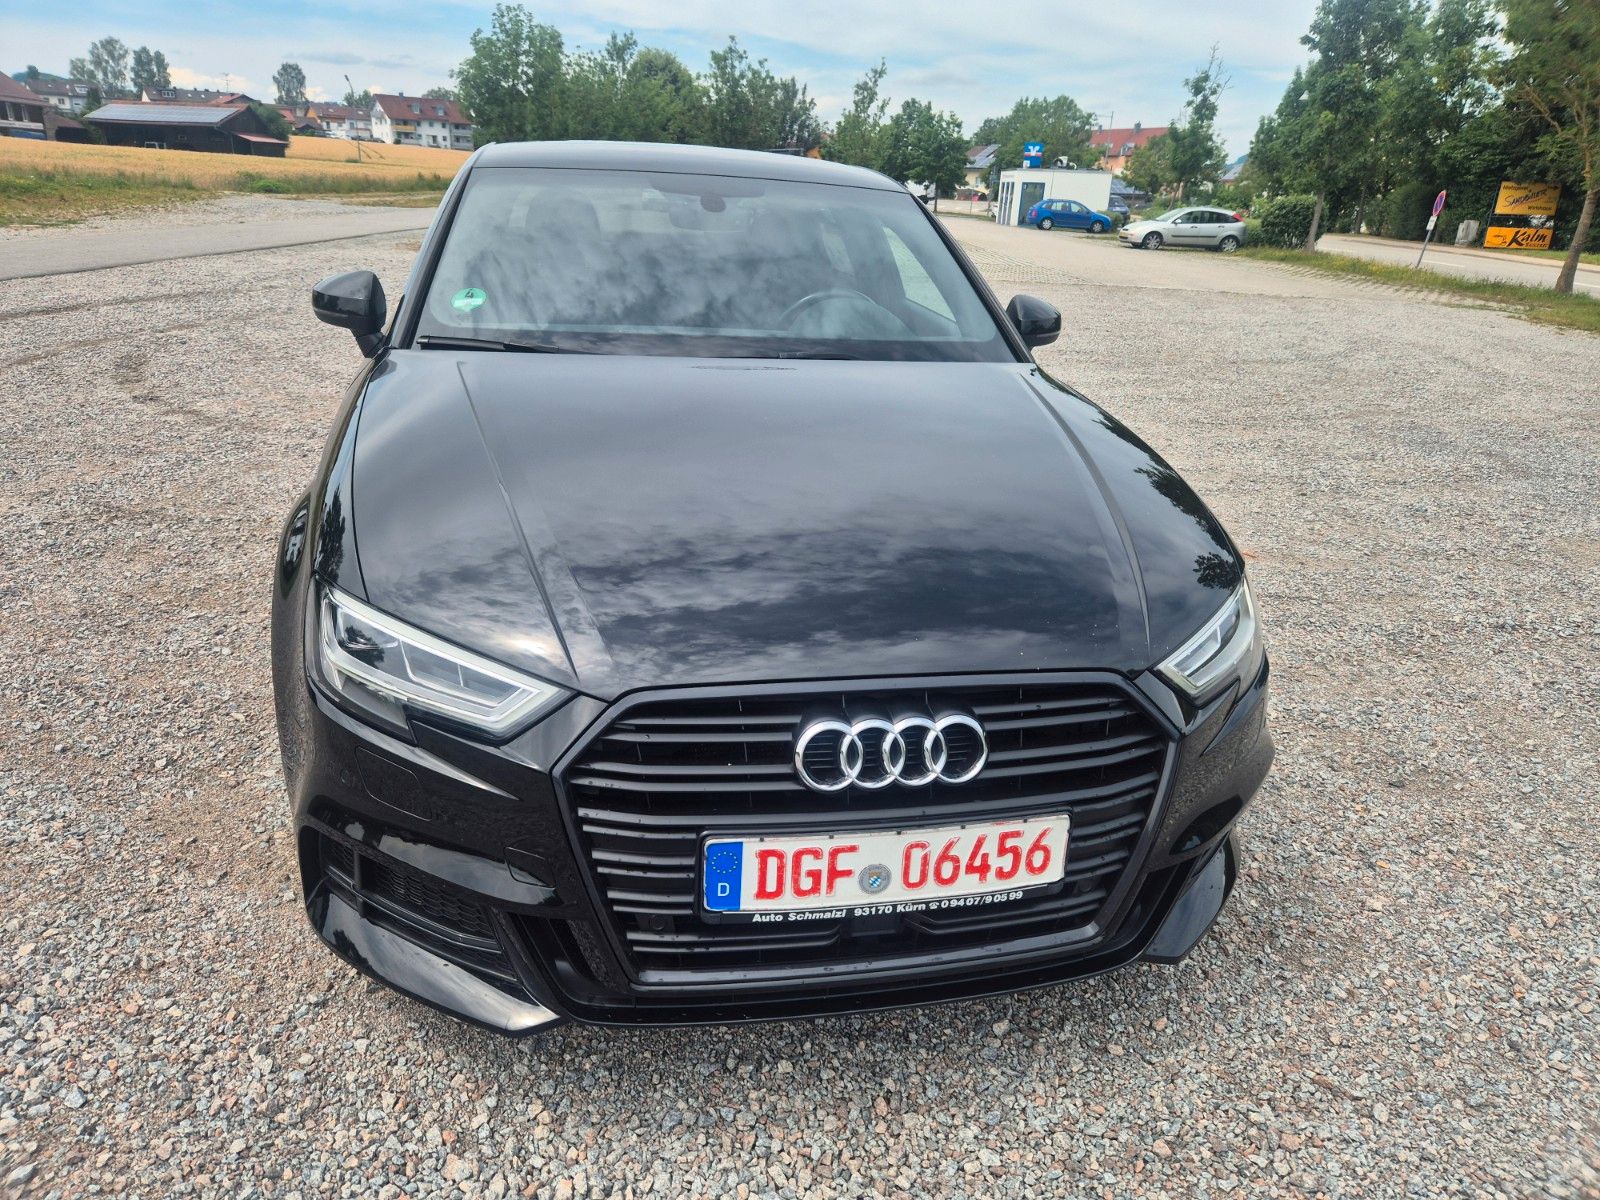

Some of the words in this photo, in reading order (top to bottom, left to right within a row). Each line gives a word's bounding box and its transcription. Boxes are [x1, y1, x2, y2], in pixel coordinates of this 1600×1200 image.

[1506, 229, 1548, 247] Kalm
[754, 844, 860, 901] DGF
[902, 827, 1054, 890] 06456
[717, 882, 730, 897] D
[752, 913, 783, 922] Auto
[788, 909, 847, 921] Schmalzl
[854, 905, 893, 916] 93170
[896, 902, 926, 913] Kürn
